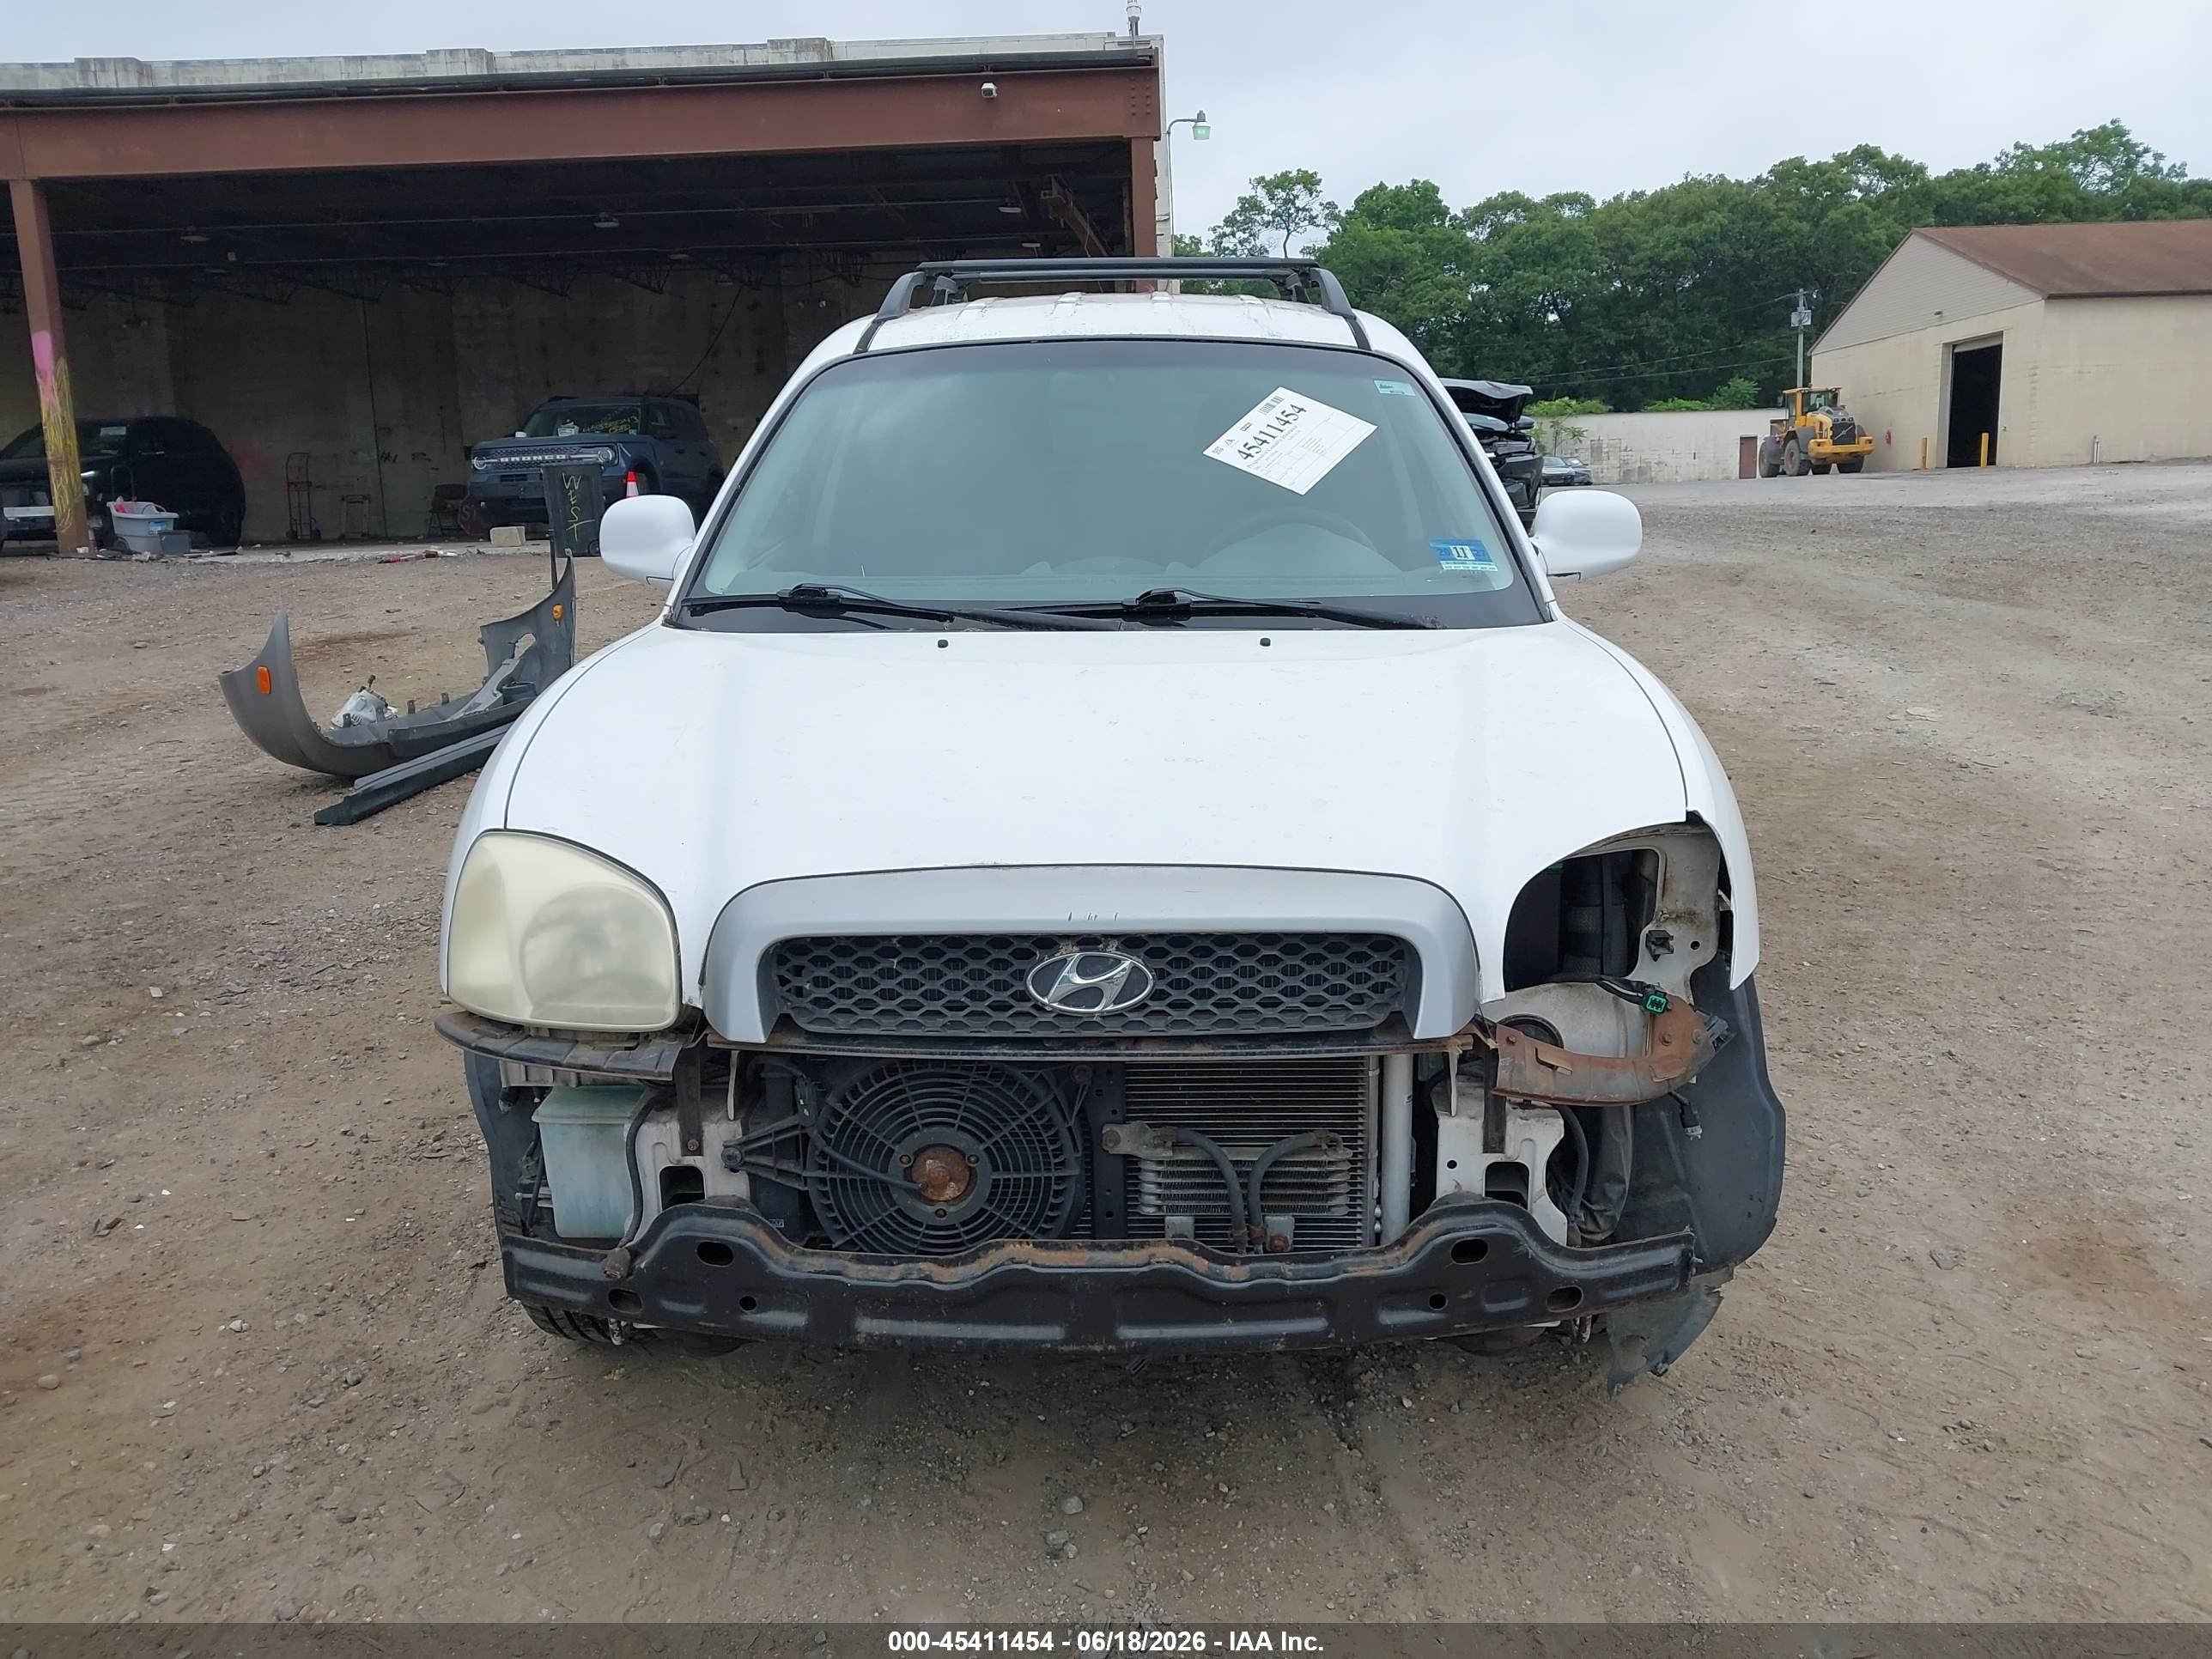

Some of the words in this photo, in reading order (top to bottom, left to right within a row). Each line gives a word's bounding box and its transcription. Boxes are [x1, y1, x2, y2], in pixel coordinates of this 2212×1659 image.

[1237, 404, 1307, 460] 45411454
[500, 453, 567, 463] BRONCO
[1453, 546, 1469, 559] 11
